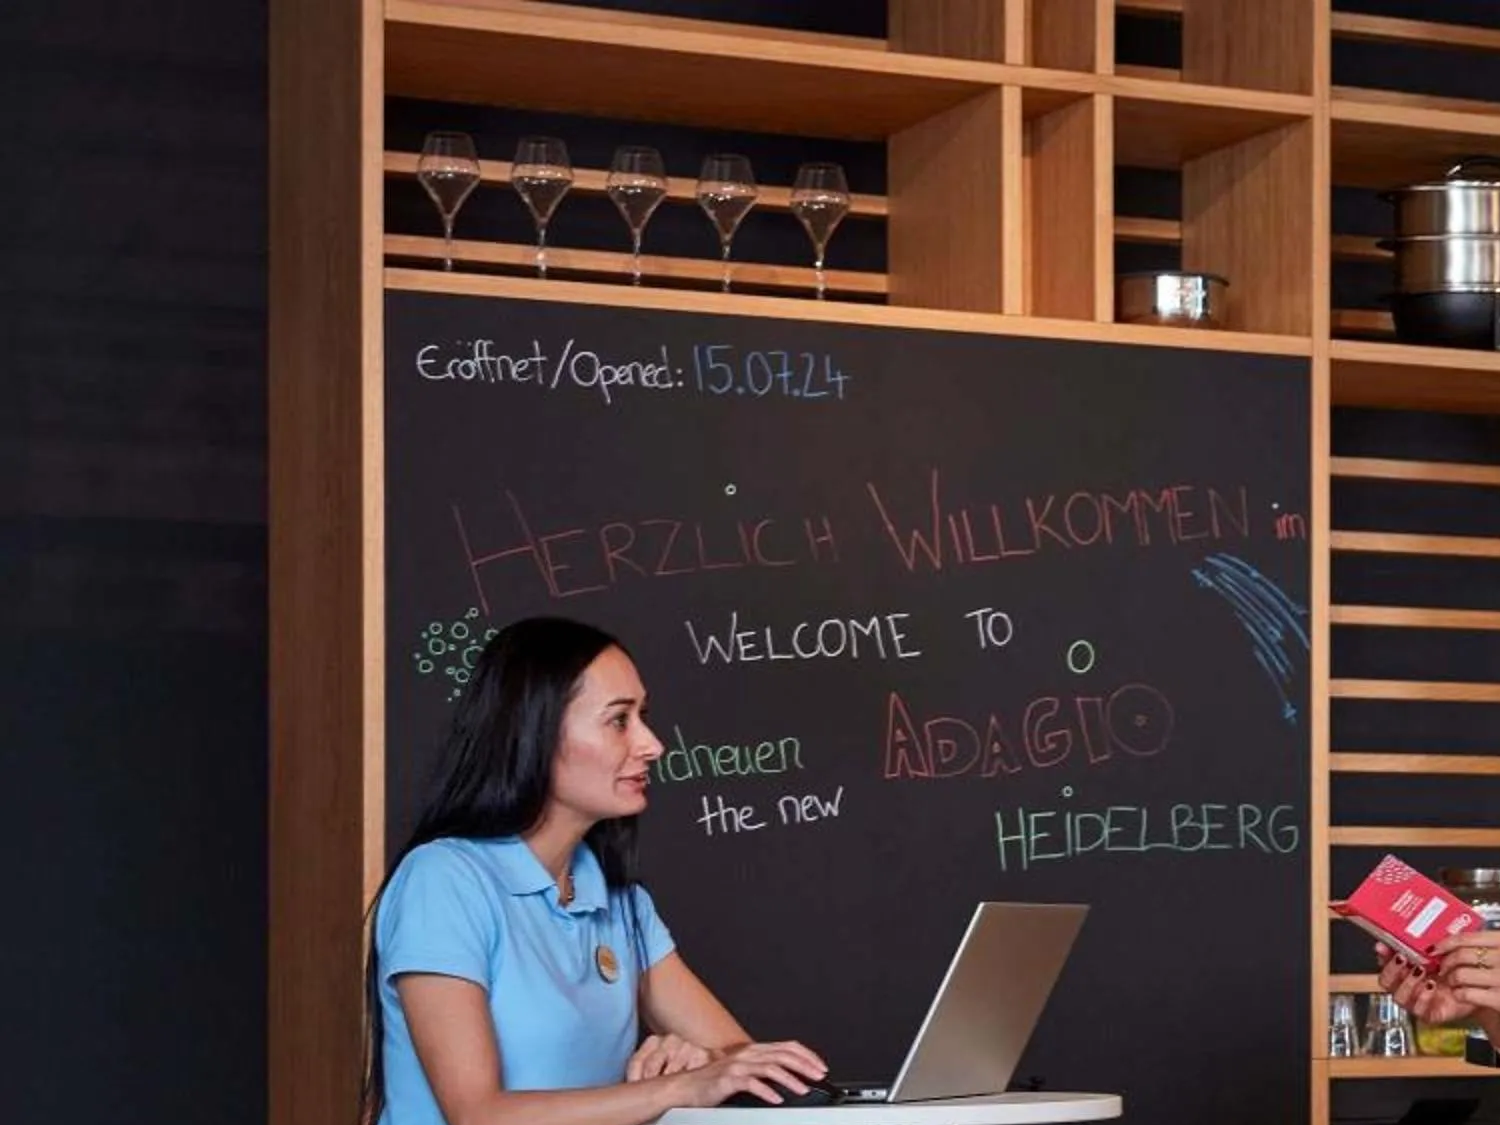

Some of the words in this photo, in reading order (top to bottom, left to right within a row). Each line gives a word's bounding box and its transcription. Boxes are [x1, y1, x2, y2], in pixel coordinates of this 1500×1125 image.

[693, 344, 850, 399] 15.07.24
[451, 488, 840, 616] HERZLICH
[866, 468, 1249, 571] WILLKOMMEN
[684, 611, 922, 665] WELCOME
[964, 607, 1014, 649] TO
[884, 682, 1175, 780] ADAGIO
[696, 794, 768, 836] the
[778, 784, 845, 826] new
[995, 787, 1299, 872] HEIDELBERG
